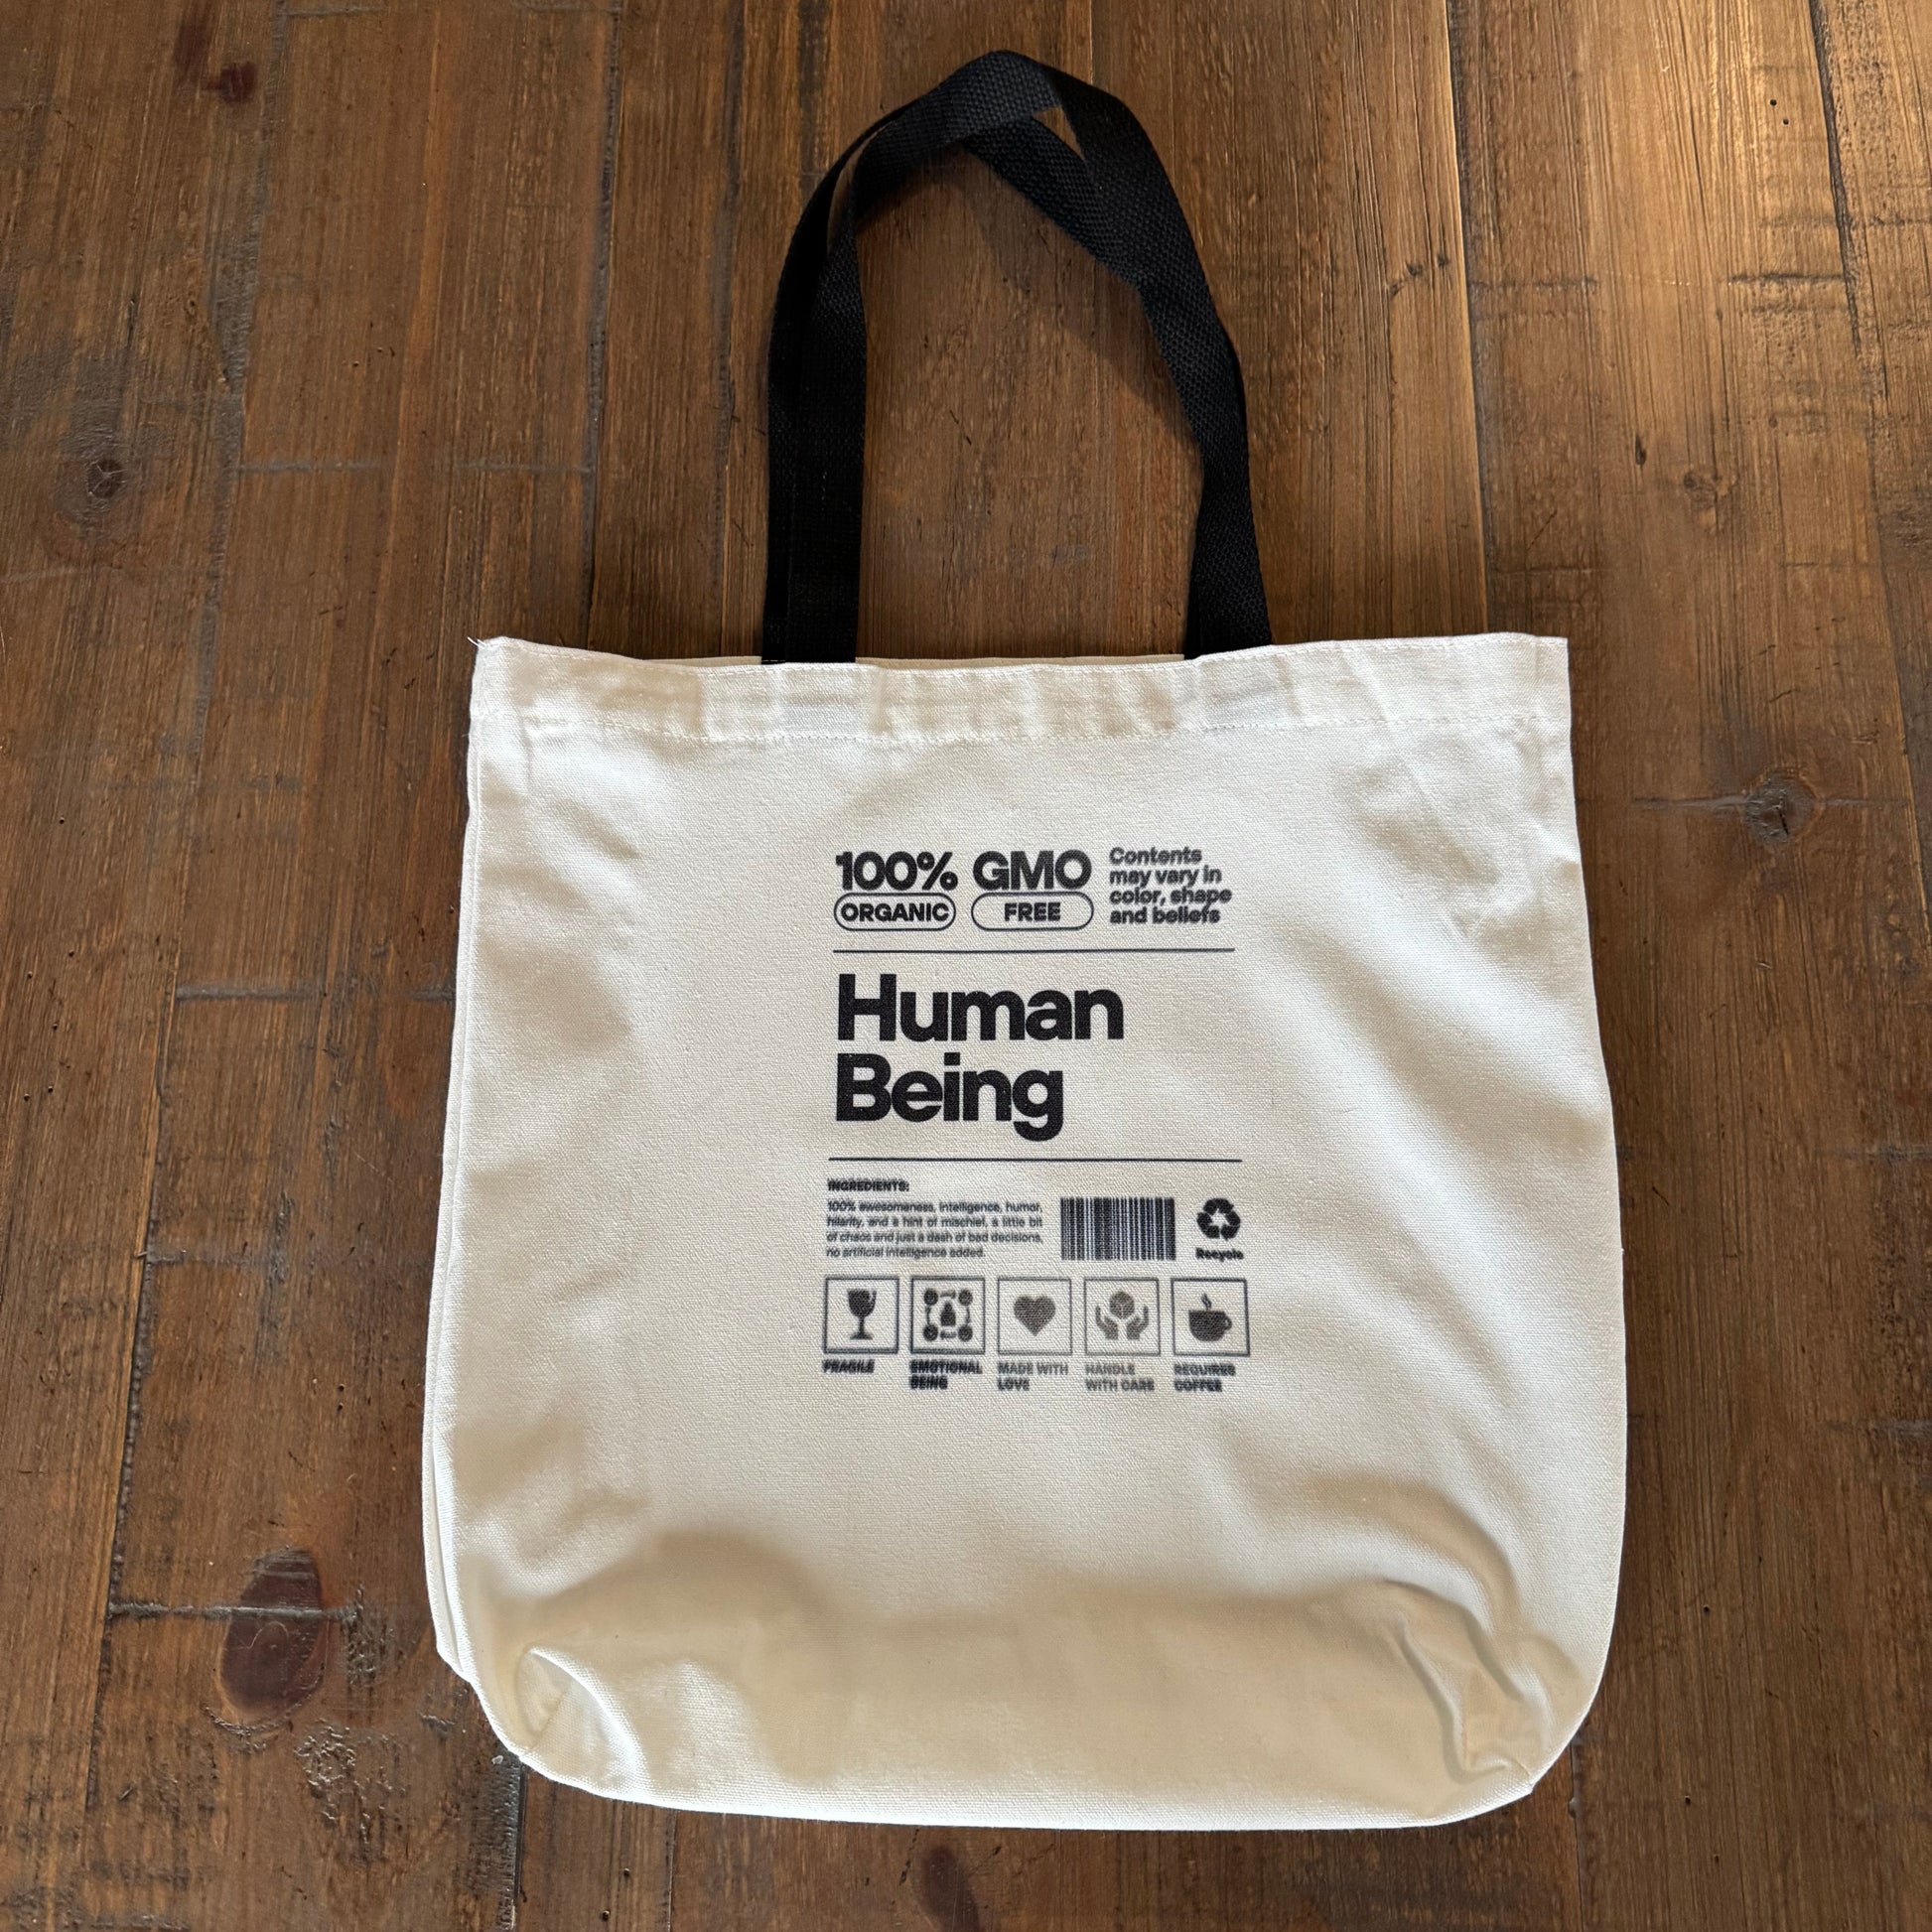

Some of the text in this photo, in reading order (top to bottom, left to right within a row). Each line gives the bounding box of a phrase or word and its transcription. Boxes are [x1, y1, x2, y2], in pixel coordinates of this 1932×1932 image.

[1109, 846, 1202, 865] Contents
[835, 851, 958, 891] 100%
[973, 849, 1092, 891] GMO
[1109, 864, 1222, 888] may vary in
[1109, 886, 1232, 909] color, shape
[841, 901, 950, 922] ORGANIC
[1004, 901, 1061, 922] FREE
[1110, 905, 1221, 923] and beliefs
[838, 973, 1124, 1042] Human
[836, 1052, 1063, 1142] Being
[827, 1200, 856, 1212] 100%
[859, 1202, 936, 1213] awesomeness,
[939, 1201, 1003, 1214] intelligence,
[869, 1216, 889, 1227] and
[893, 1217, 899, 1227] a
[903, 1216, 922, 1227] hint
[927, 1216, 937, 1227] of
[992, 1218, 999, 1228] a
[1002, 1216, 1025, 1228] little
[1030, 1216, 1042, 1228] bit
[827, 1231, 838, 1242] of
[840, 1231, 871, 1242] chaos
[874, 1231, 894, 1242] and
[896, 1231, 915, 1244] just
[918, 1233, 924, 1242] a
[927, 1232, 953, 1242] dash
[955, 1232, 966, 1242] of
[968, 1232, 989, 1242] bad
[826, 1246, 986, 1259] no artificial intelligence added.
[822, 1359, 875, 1374] FRAGILE
[909, 1359, 983, 1374] EMOTIONAL
[997, 1361, 1068, 1375] MADE WITH
[1085, 1363, 1135, 1375] HANDLE
[1173, 1363, 1236, 1376] REQUIRES
[909, 1375, 948, 1390] BEING
[997, 1377, 1030, 1391] LOVE
[1085, 1378, 1155, 1391] WITH CARE
[1173, 1378, 1222, 1392] COFFEE
